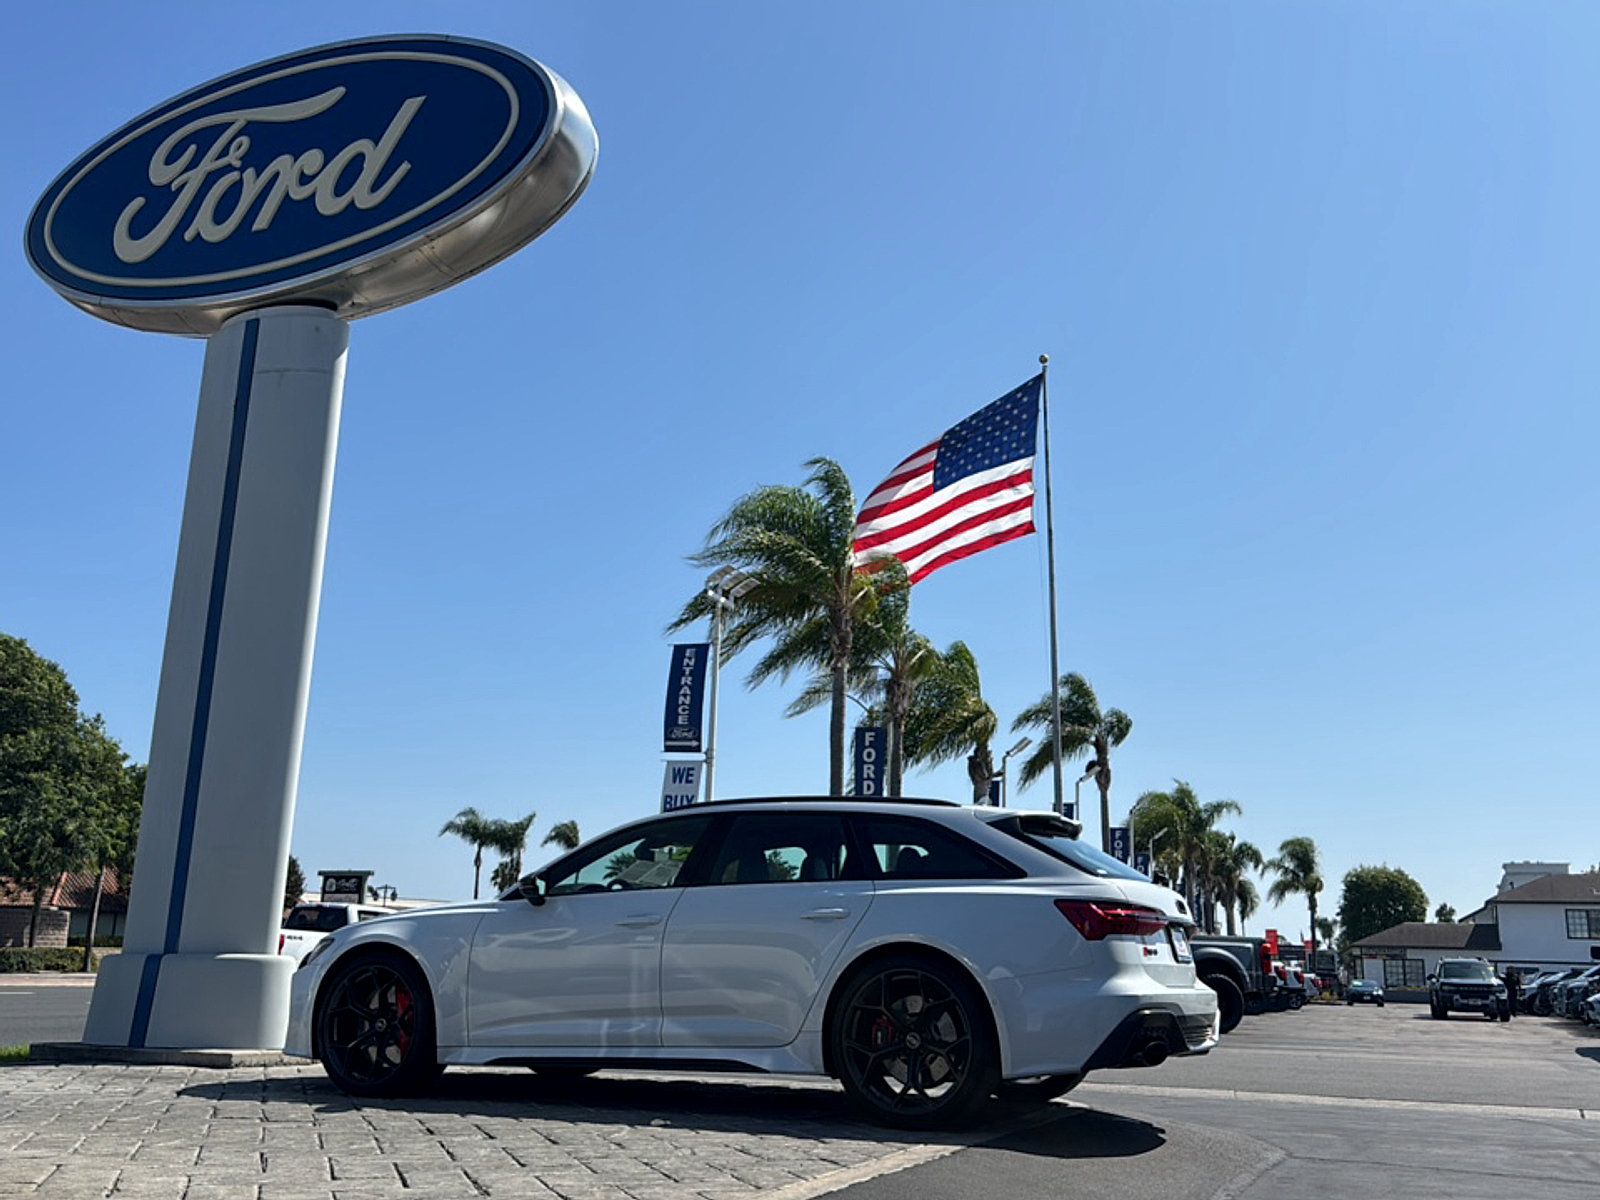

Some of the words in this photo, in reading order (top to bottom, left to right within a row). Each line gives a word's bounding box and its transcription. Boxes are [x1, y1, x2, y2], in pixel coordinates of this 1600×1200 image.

[113, 86, 426, 263] Ford
[678, 648, 696, 725] ENTRANCE
[672, 767, 695, 784] WE
[863, 731, 877, 795] FORD
[664, 795, 695, 812] BUY
